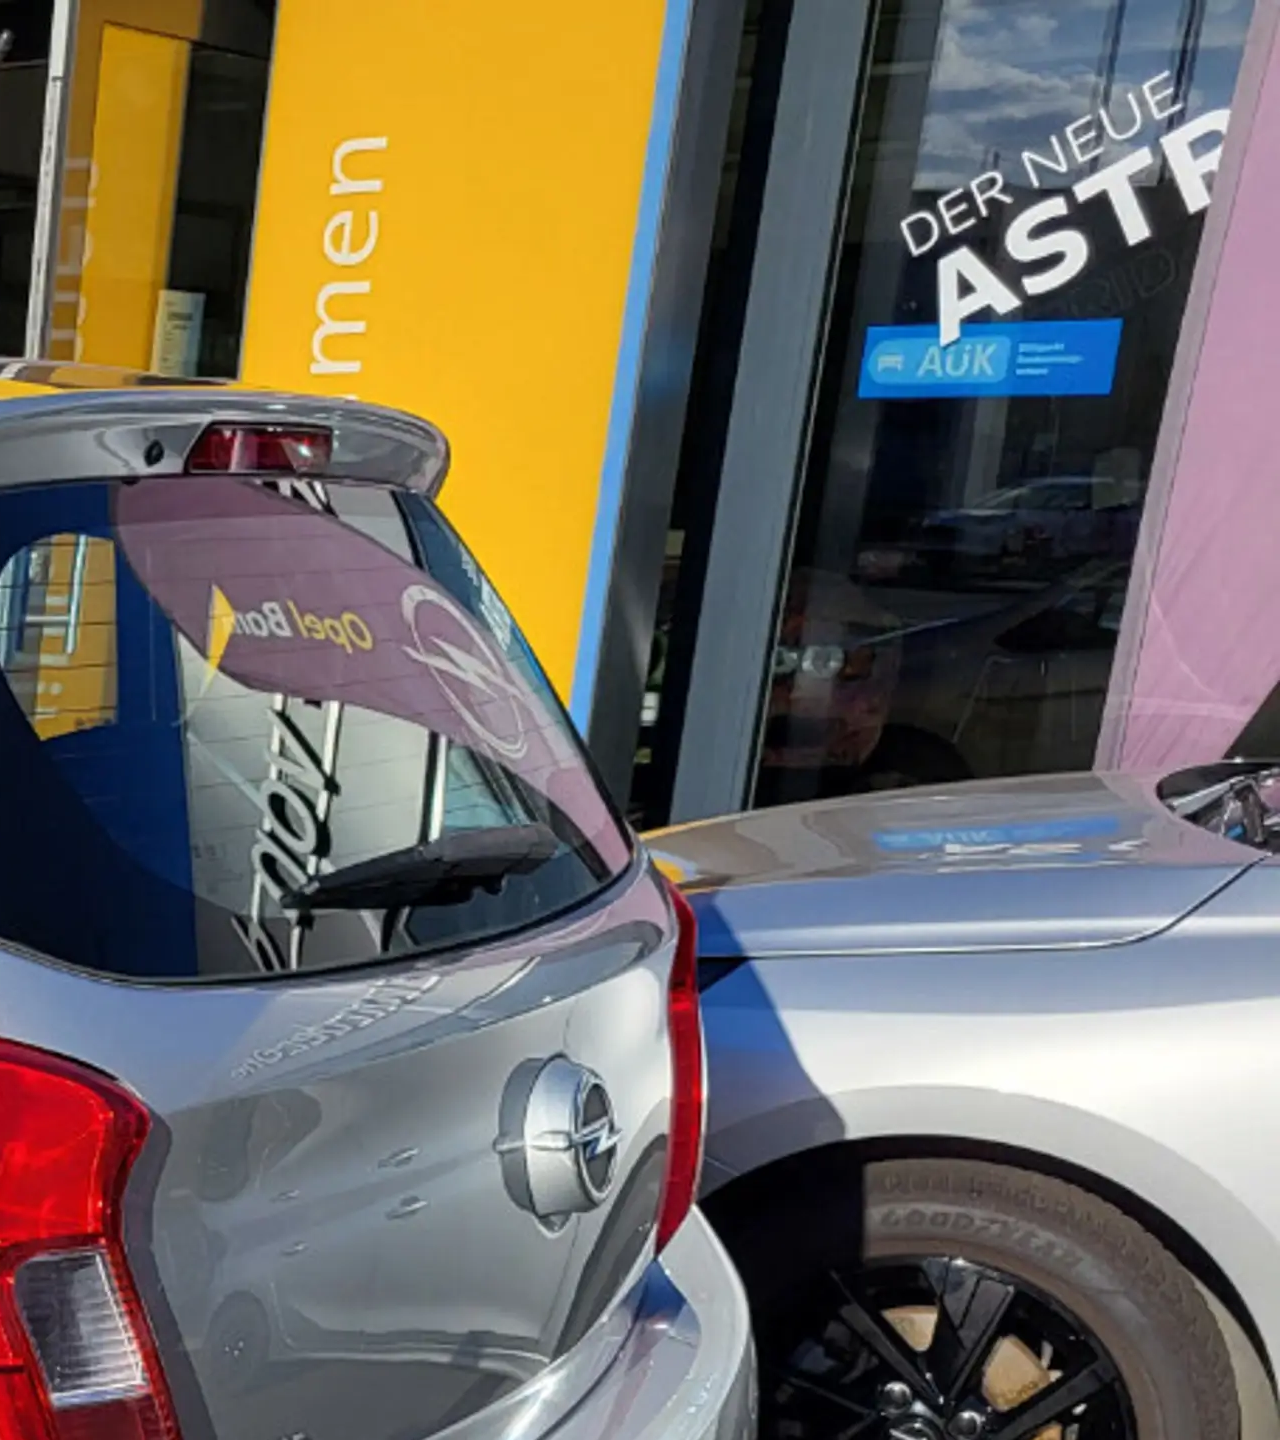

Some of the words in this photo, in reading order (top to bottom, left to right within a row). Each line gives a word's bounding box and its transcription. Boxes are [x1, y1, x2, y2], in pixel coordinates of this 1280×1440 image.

[308, 135, 390, 400] men
[899, 170, 1014, 258] DER
[1020, 69, 1184, 189] NEUE
